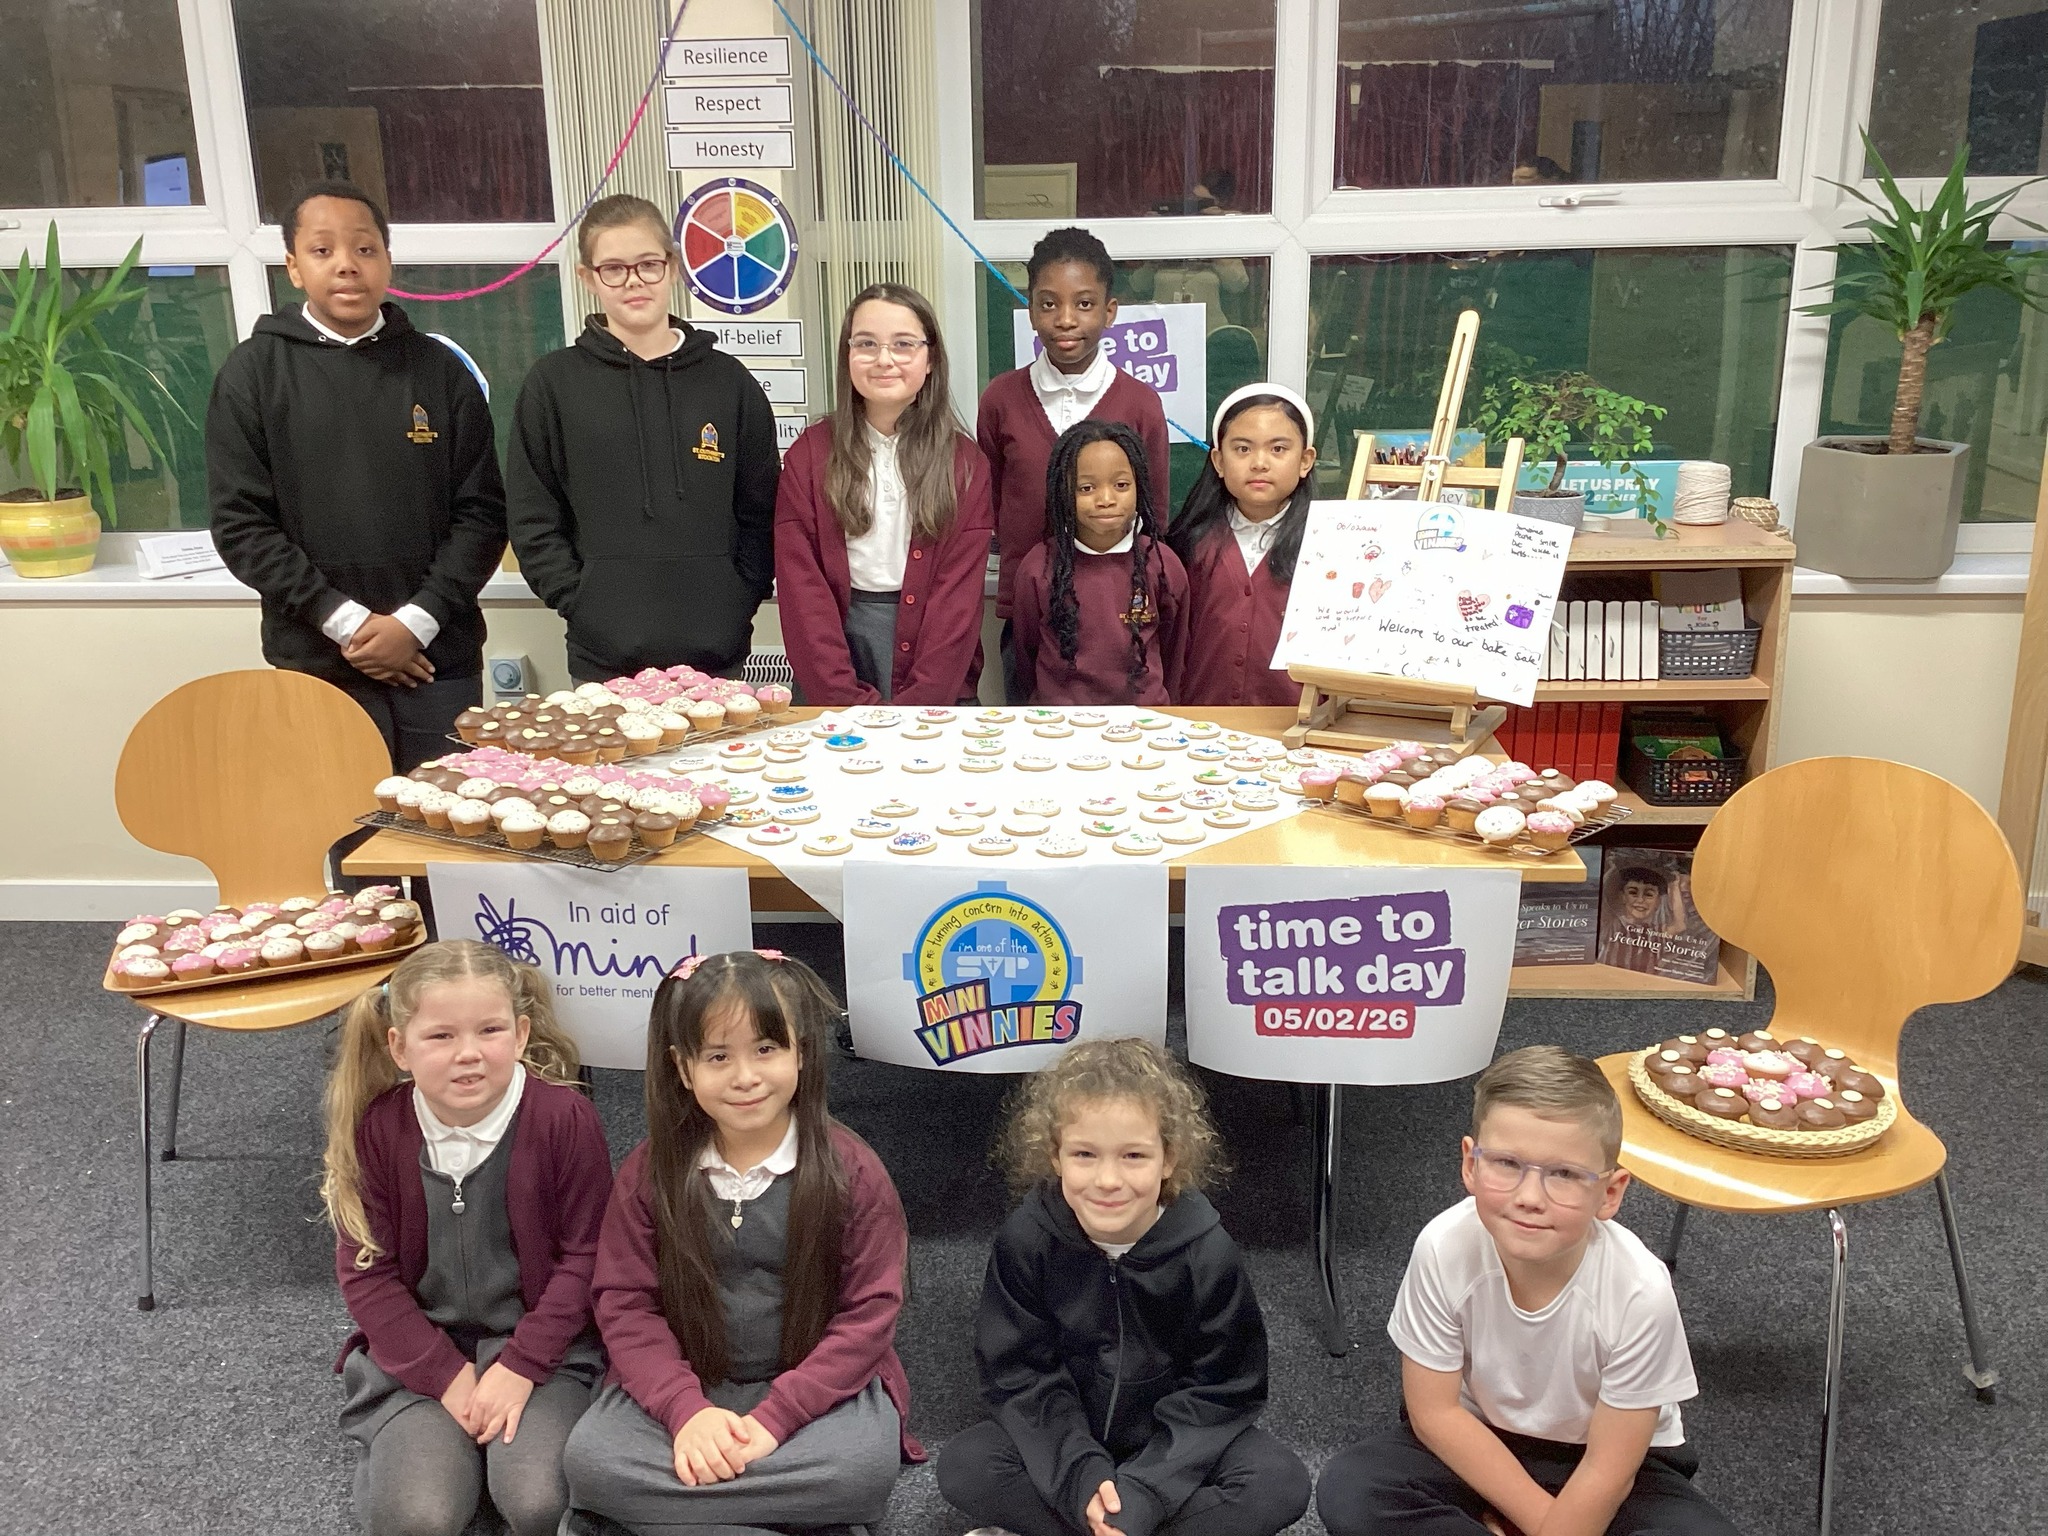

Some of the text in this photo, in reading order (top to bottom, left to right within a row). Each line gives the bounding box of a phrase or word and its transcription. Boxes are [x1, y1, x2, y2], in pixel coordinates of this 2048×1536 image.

[684, 47, 768, 65] Resilience
[695, 96, 762, 115] Respect
[696, 141, 764, 160] Honesty
[716, 329, 782, 345] lf-belief
[1124, 329, 1158, 353] to
[1561, 478, 1660, 491] LET US PRY
[1378, 619, 1424, 639] Welcome
[1433, 630, 1446, 643] to
[1451, 637, 1473, 648] our
[1481, 639, 1508, 657] bake
[569, 901, 670, 926] In aid of
[1521, 902, 1551, 914] Speaks
[1552, 903, 1560, 911] to
[926, 902, 1054, 949] turning concern into action
[1233, 904, 1435, 951] time to
[1538, 915, 1589, 929] Stories
[976, 944, 992, 953] one
[995, 938, 1007, 953] of
[1011, 938, 1028, 954] the
[1609, 931, 1708, 960] Feeding Stories
[1626, 924, 1644, 934] God
[1646, 927, 1673, 940] Speaks
[1698, 937, 1708, 947] in
[1237, 953, 1453, 1000] talk day
[556, 984, 574, 997] for
[580, 985, 618, 998] better
[922, 983, 986, 1026] MINI
[1263, 1007, 1408, 1032] 05/02/26
[921, 1004, 1077, 1061] VINNIES
